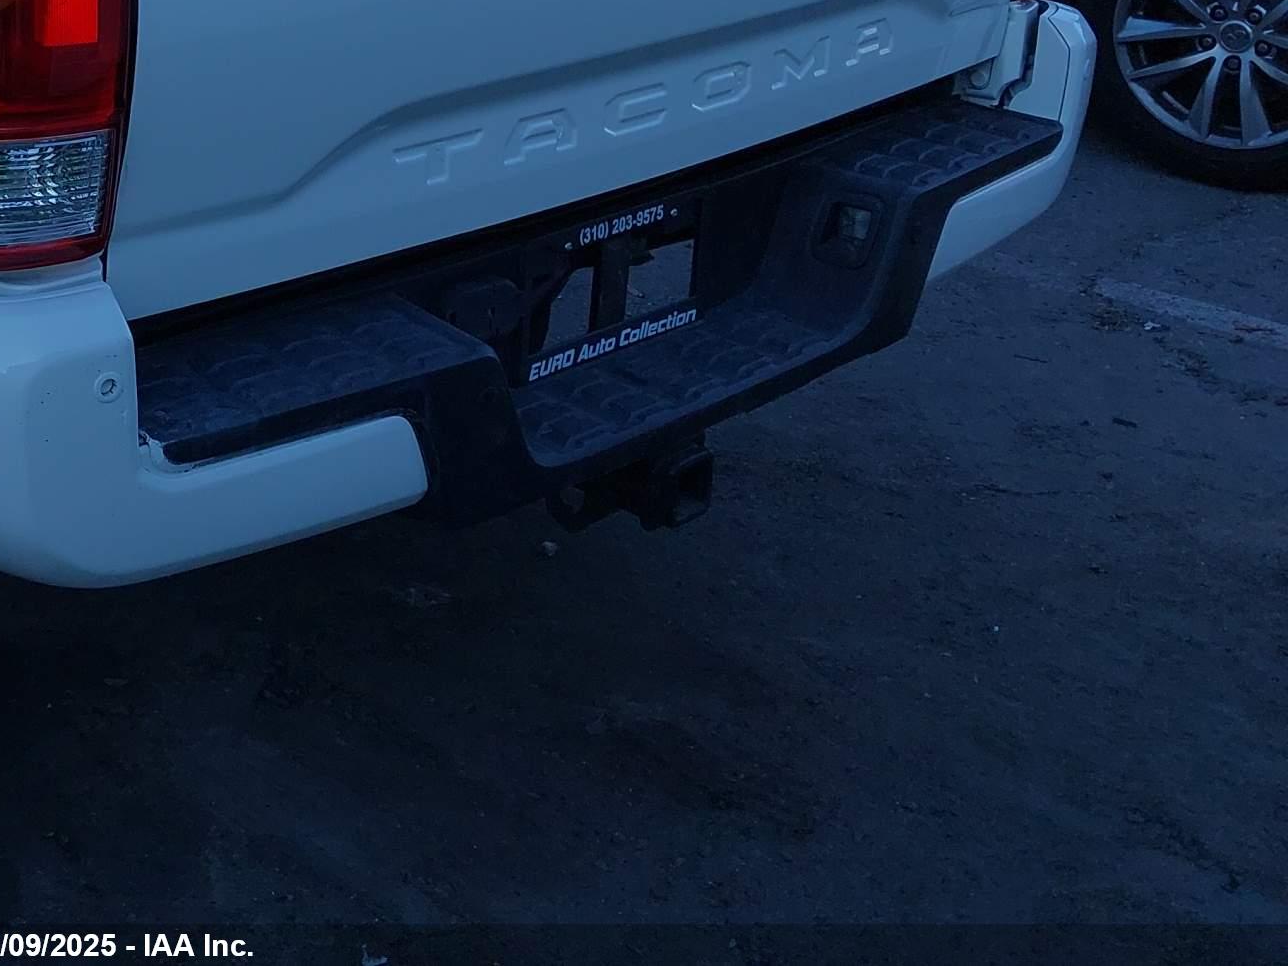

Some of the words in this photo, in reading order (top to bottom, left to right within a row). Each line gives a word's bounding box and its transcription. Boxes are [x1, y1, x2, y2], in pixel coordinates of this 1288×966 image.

[391, 16, 895, 186] TACOMA
[579, 222, 608, 246] (310)
[611, 203, 665, 235] 203-9575
[528, 348, 575, 382] EURO
[576, 335, 616, 363] Auto
[618, 309, 696, 346] Collection
